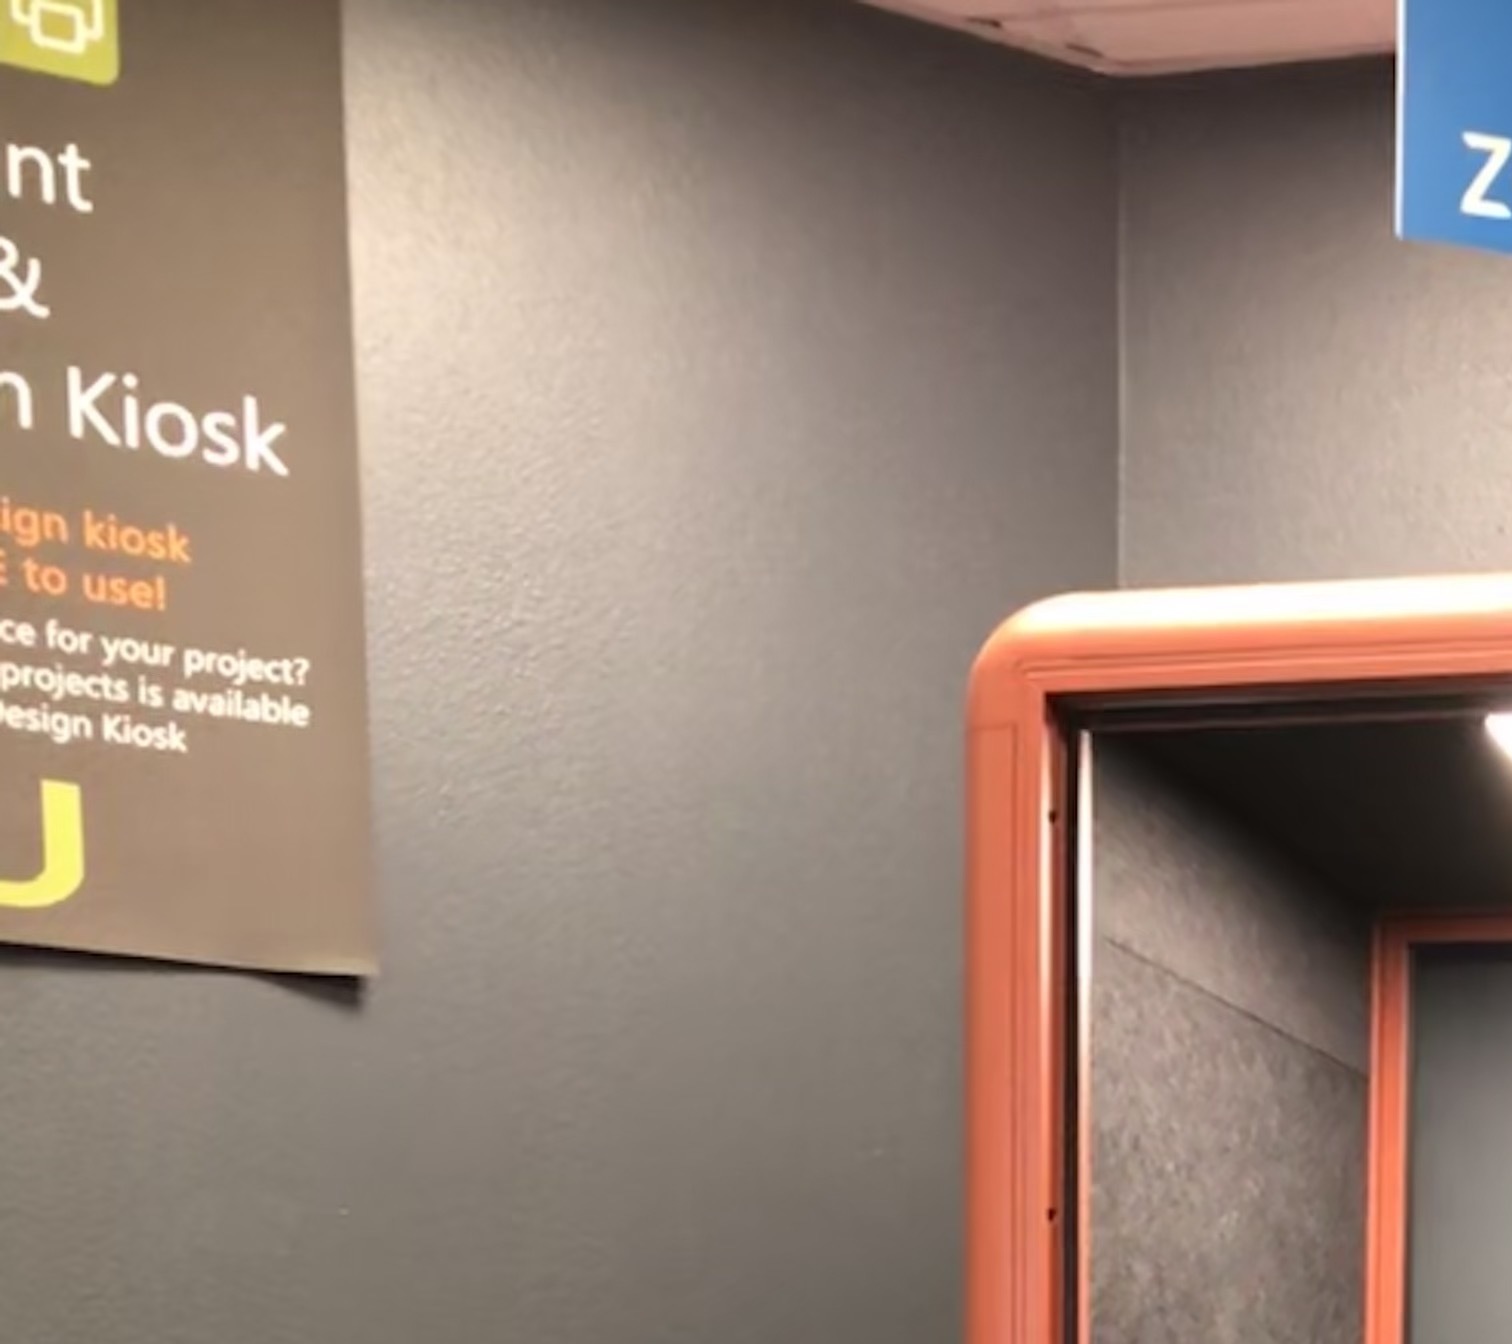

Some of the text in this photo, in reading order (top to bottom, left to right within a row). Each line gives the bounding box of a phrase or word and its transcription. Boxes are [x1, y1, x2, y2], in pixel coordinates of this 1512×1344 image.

[6, 142, 94, 214] nt
[66, 365, 290, 478] Kiosk
[0, 496, 191, 564] ign kiosk
[22, 556, 68, 596] to
[81, 572, 166, 612] use!
[45, 618, 93, 655] for
[100, 635, 176, 667] your
[183, 647, 311, 687] project?
[0, 660, 311, 728] projects is available
[0, 701, 188, 754] esign Kiosk
